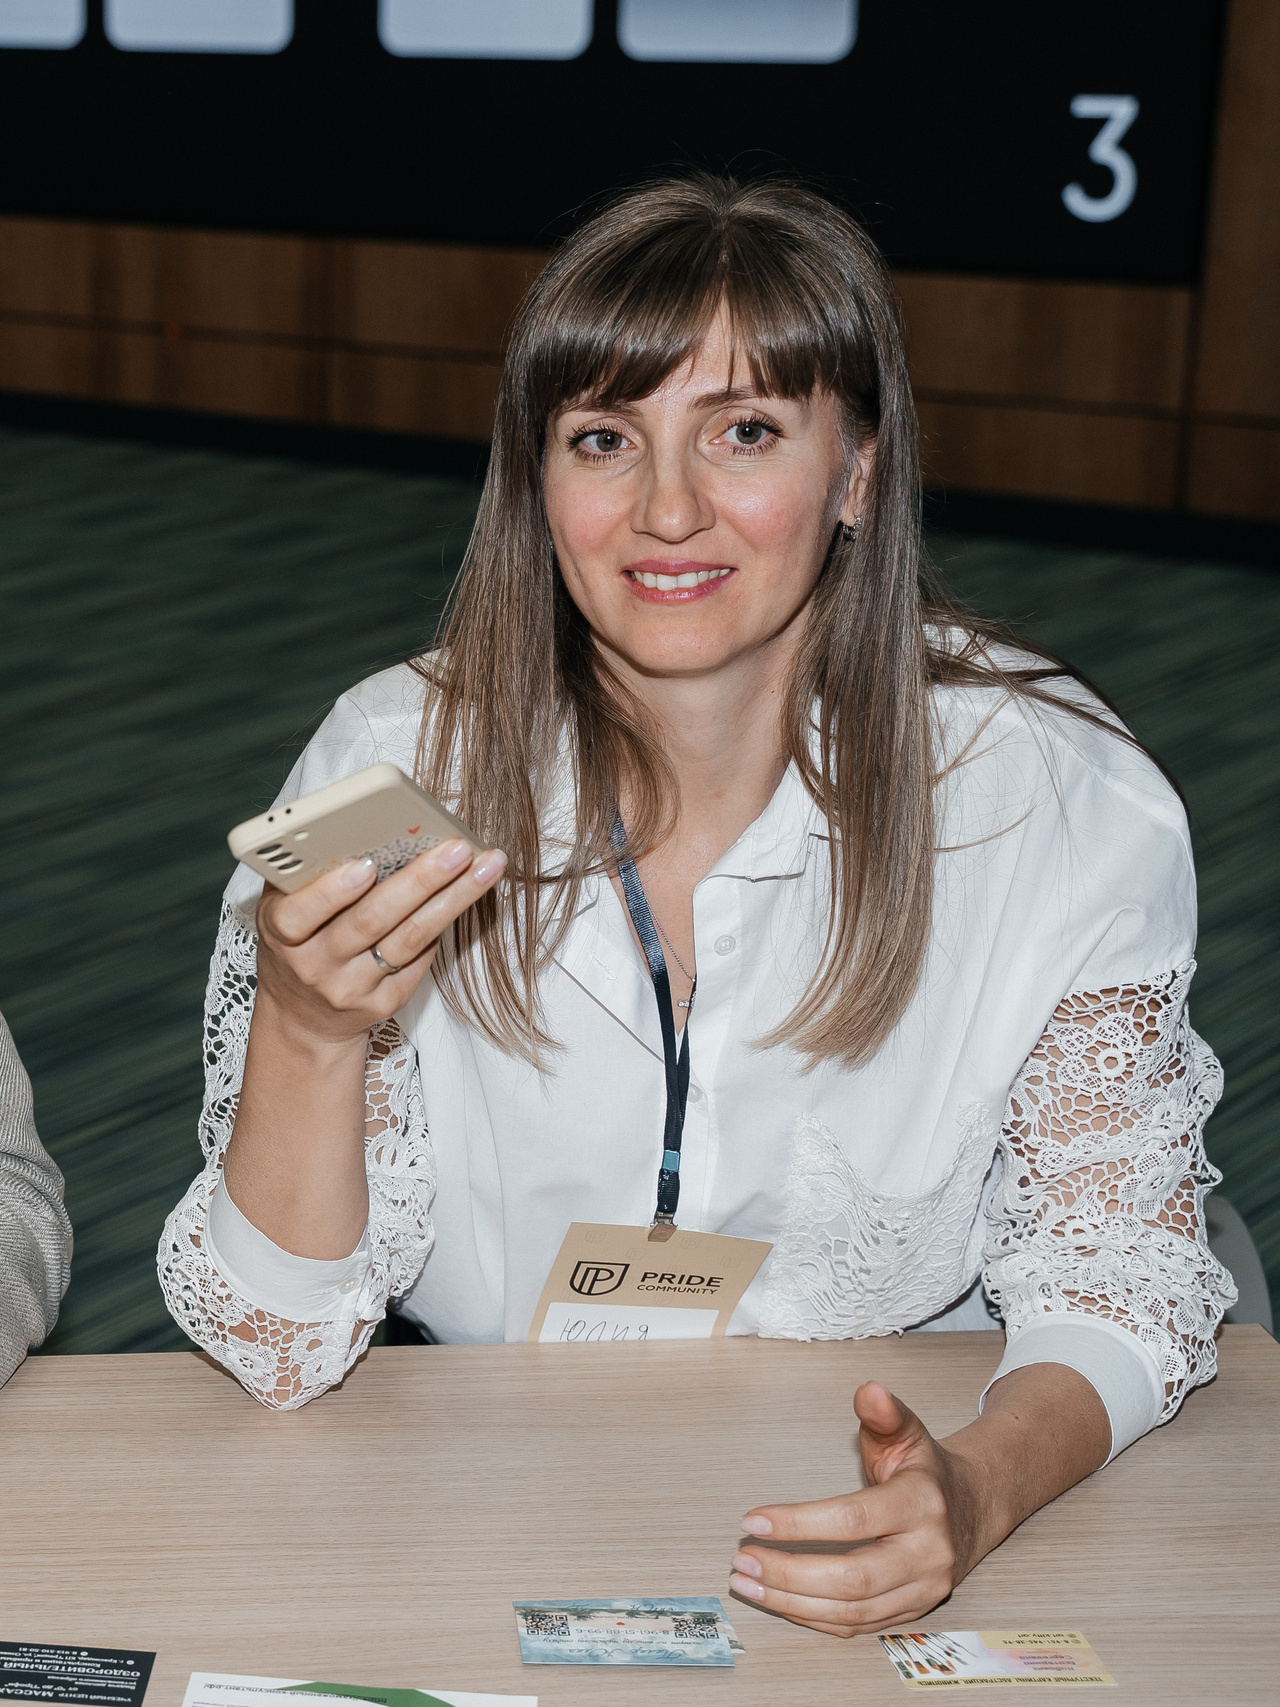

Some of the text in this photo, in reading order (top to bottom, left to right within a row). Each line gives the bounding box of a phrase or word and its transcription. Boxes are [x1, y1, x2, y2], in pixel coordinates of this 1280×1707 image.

[1061, 94, 1140, 223] 3
[640, 1271, 724, 1288] PRIDE
[636, 1284, 718, 1295] COMMUNITY
[3, 1662, 140, 1677] ОЗДОРОВИТЕЛЬНЫЙ
